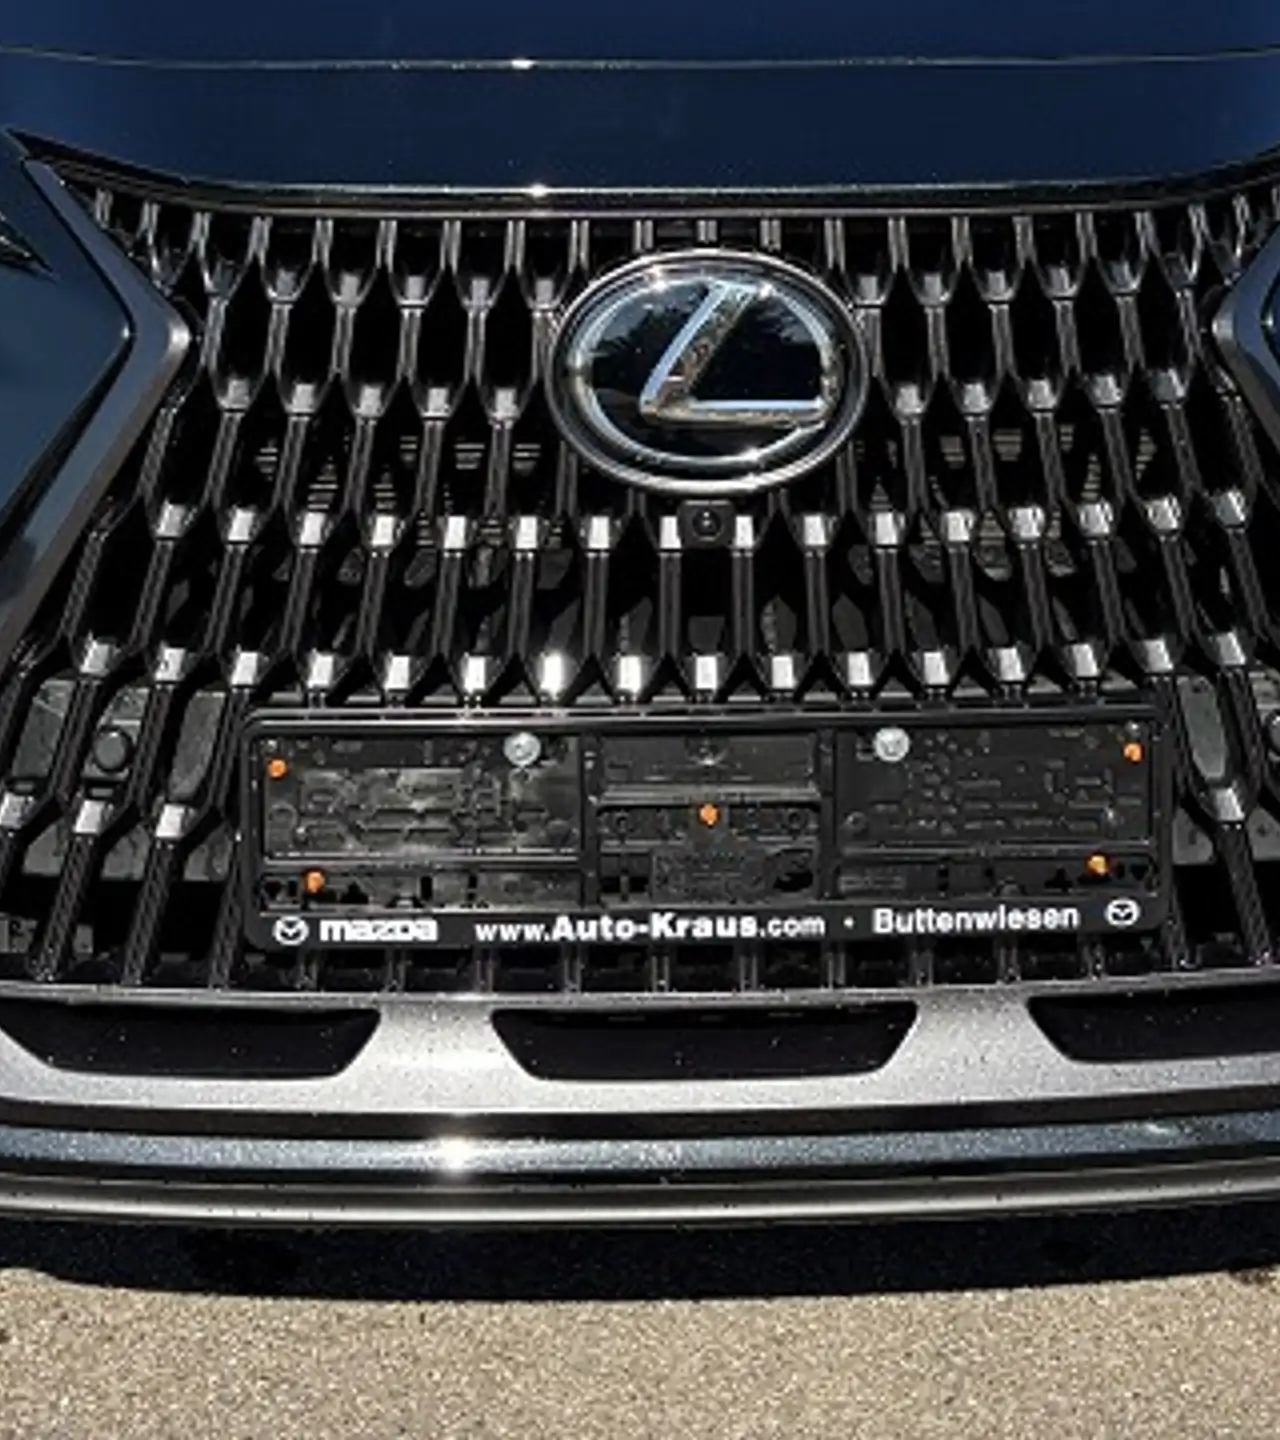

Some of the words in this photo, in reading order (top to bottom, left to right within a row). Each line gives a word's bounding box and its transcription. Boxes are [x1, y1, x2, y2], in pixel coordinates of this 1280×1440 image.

[319, 917, 439, 943] mazda
[474, 910, 826, 942] www.Auto-Kraus.com
[871, 903, 1081, 935] Buttenwiesen
